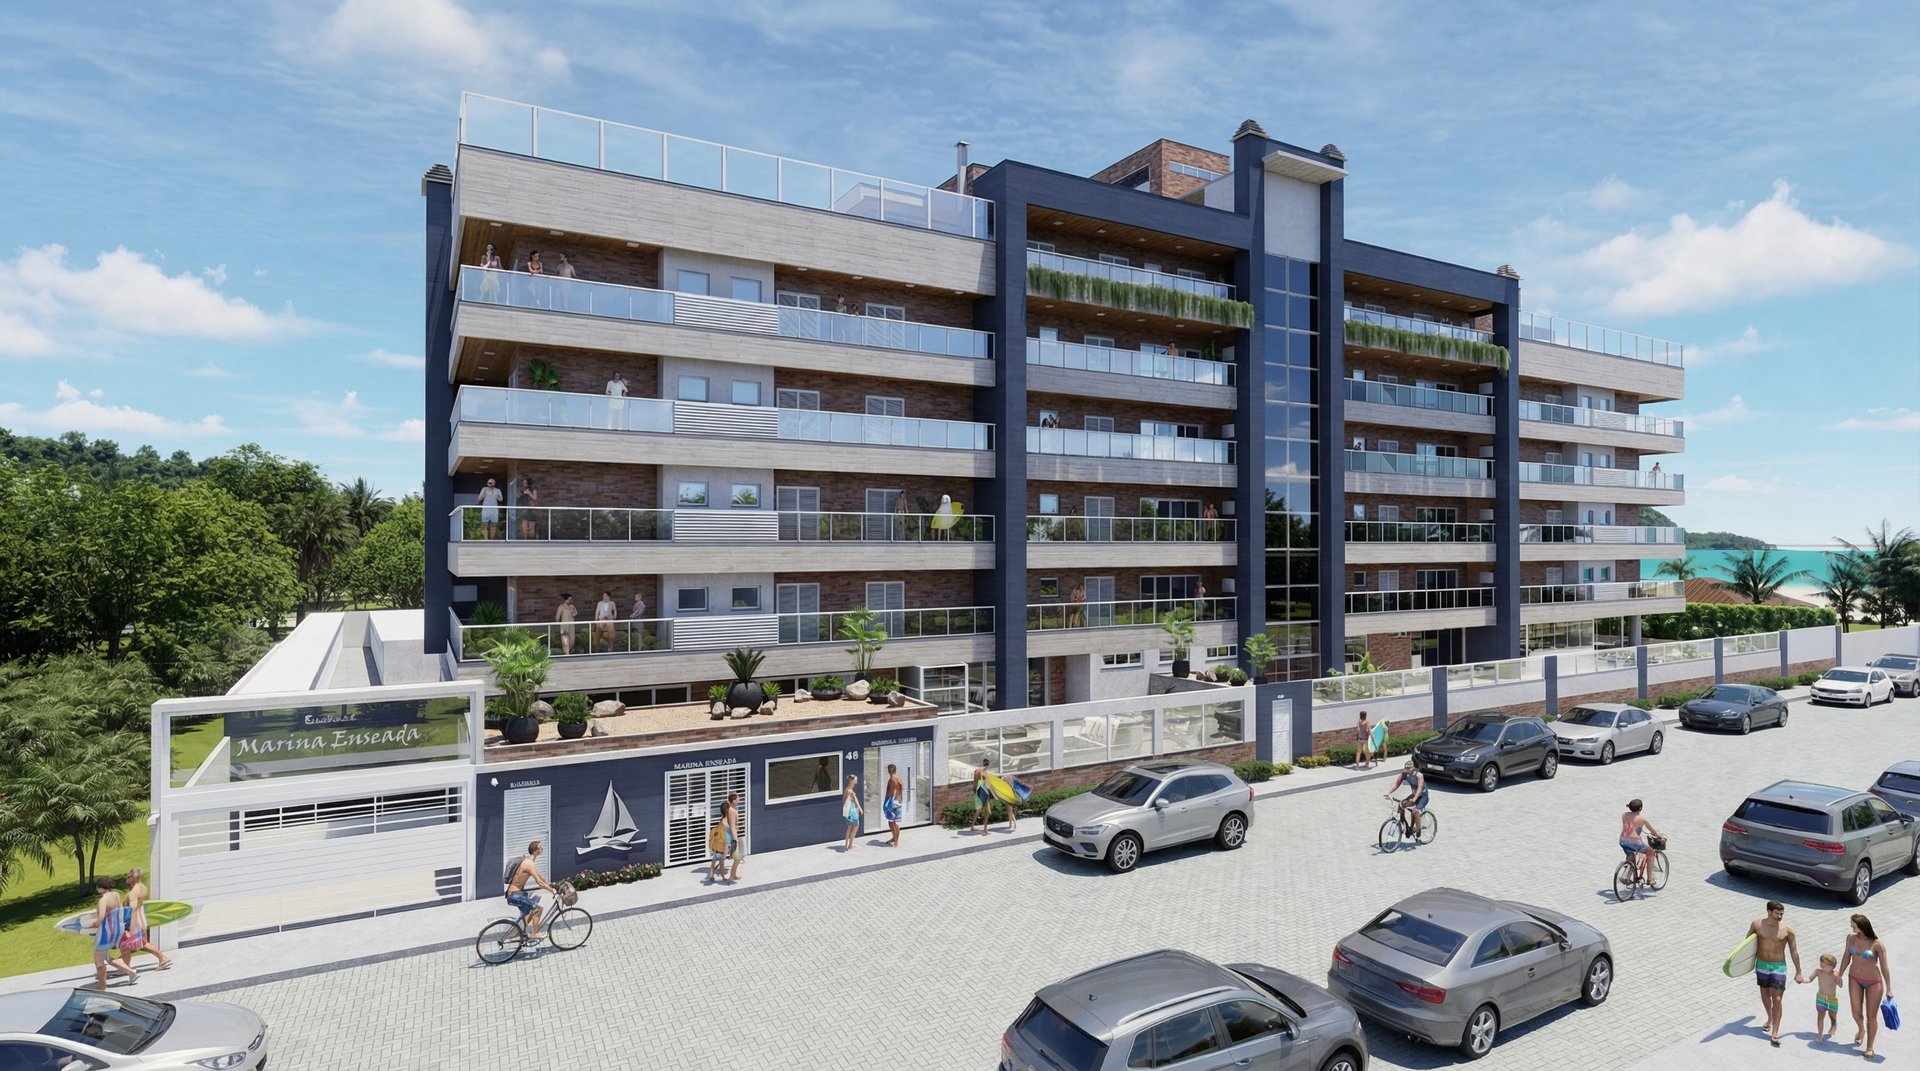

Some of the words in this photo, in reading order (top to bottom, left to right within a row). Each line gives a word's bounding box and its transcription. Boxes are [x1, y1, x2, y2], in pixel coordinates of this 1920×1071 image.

[236, 734, 327, 757] Marina
[331, 724, 421, 749] Enseada
[845, 750, 859, 761] 48
